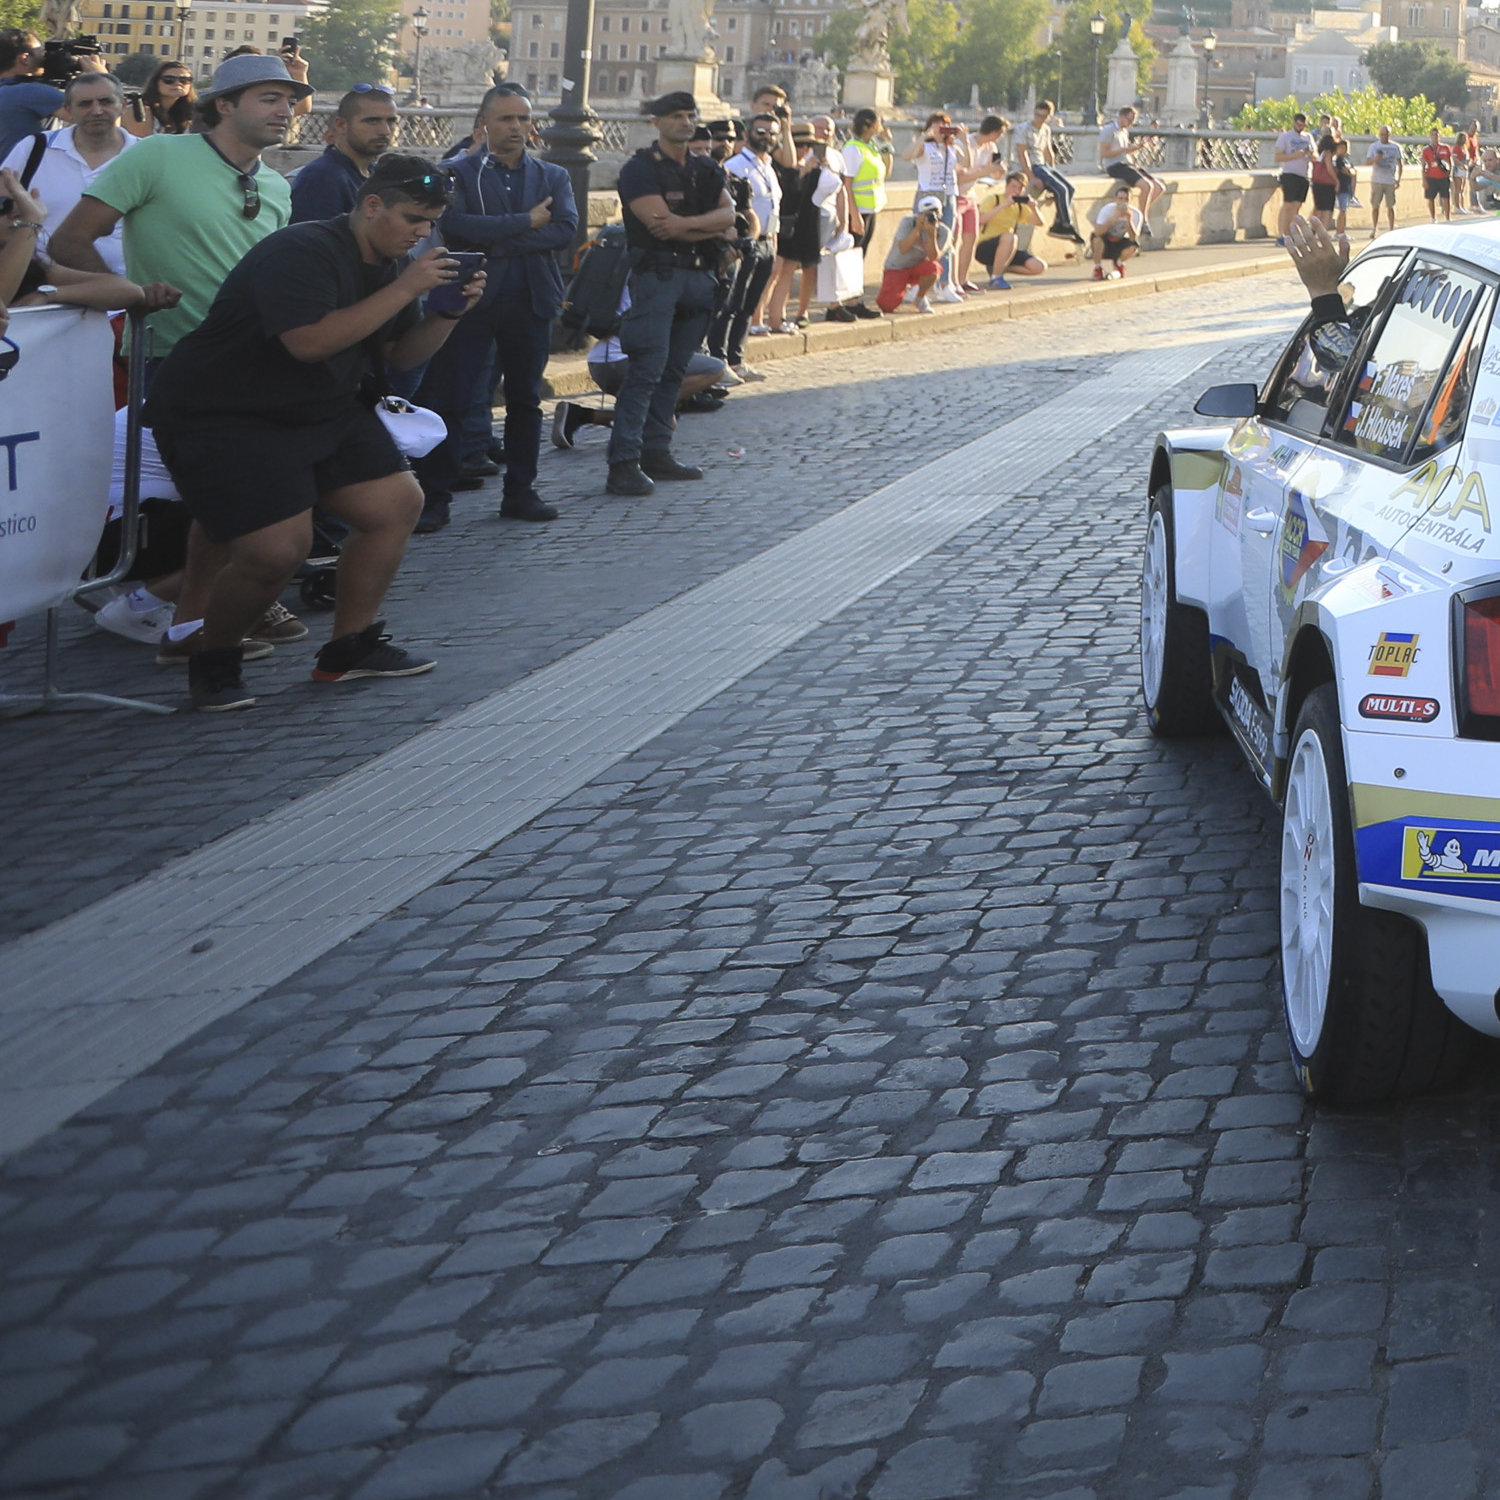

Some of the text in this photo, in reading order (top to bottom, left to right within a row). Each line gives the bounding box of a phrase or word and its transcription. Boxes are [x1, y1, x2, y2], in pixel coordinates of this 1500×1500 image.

[1388, 460, 1492, 535] ACA
[1376, 504, 1486, 554] AUTOCENTRÁLA
[1367, 644, 1422, 664] TOPLAC
[1365, 698, 1436, 716] MULTI-S
